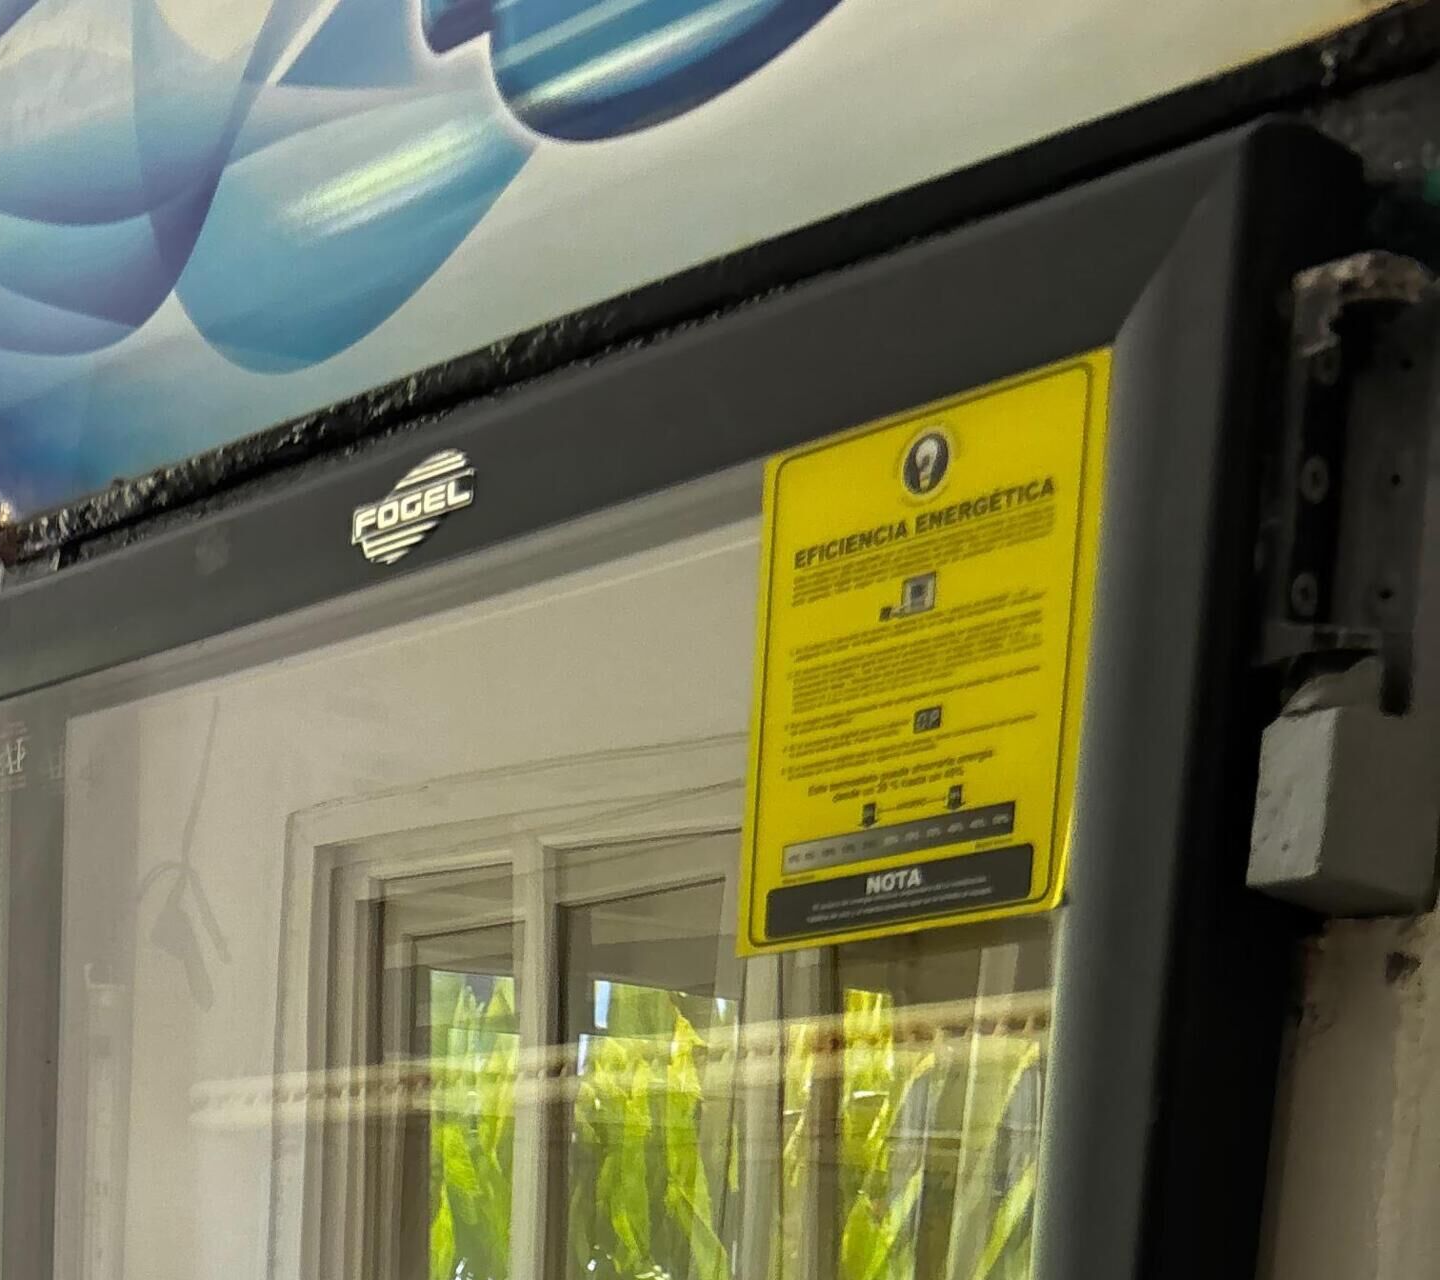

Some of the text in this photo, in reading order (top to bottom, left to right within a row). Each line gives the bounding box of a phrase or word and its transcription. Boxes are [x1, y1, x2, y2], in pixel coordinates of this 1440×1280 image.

[355, 480, 471, 538] FOGEL
[794, 519, 908, 570] EFICIENCIA
[914, 475, 1056, 534] ENERGÉTICA
[865, 866, 923, 895] NOTA
